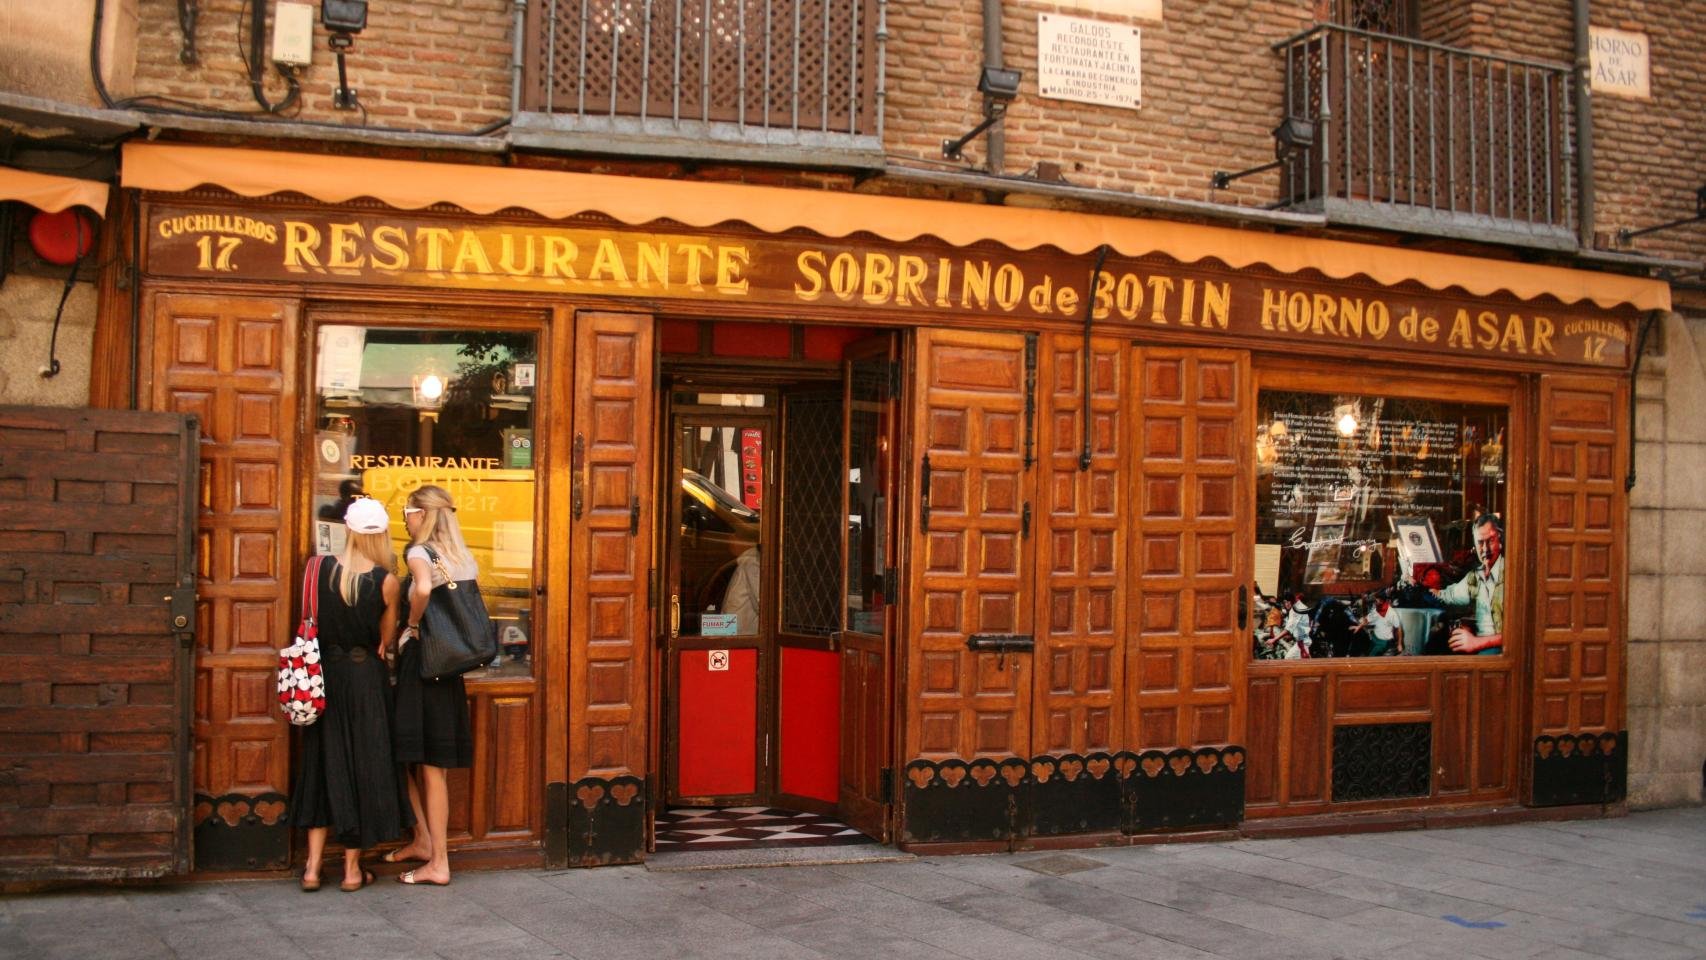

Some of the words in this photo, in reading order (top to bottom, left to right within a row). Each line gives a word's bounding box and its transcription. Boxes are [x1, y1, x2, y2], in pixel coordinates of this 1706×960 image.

[1051, 43, 1115, 60] RESTAURANTE
[1118, 52, 1130, 63] EN
[1100, 39, 1125, 51] ESTE
[1589, 35, 1642, 57] HORNO
[1043, 54, 1094, 69] FORTUNATA
[1100, 62, 1136, 74] JACINTA
[1594, 62, 1637, 87] ASAR
[1099, 73, 1138, 87] COMERCIO
[158, 214, 278, 245] CUCHILLEROS
[282, 220, 750, 297] RESTAURANTE
[794, 249, 1025, 311] SOBRINO
[1029, 273, 1080, 317] de
[1089, 269, 1232, 330] BOTIN
[1260, 288, 1390, 340] HORNO
[1400, 306, 1440, 343] de
[1447, 308, 1557, 356] ASAR
[1583, 335, 1607, 363] 17
[349, 454, 500, 470] RESTAURANTE
